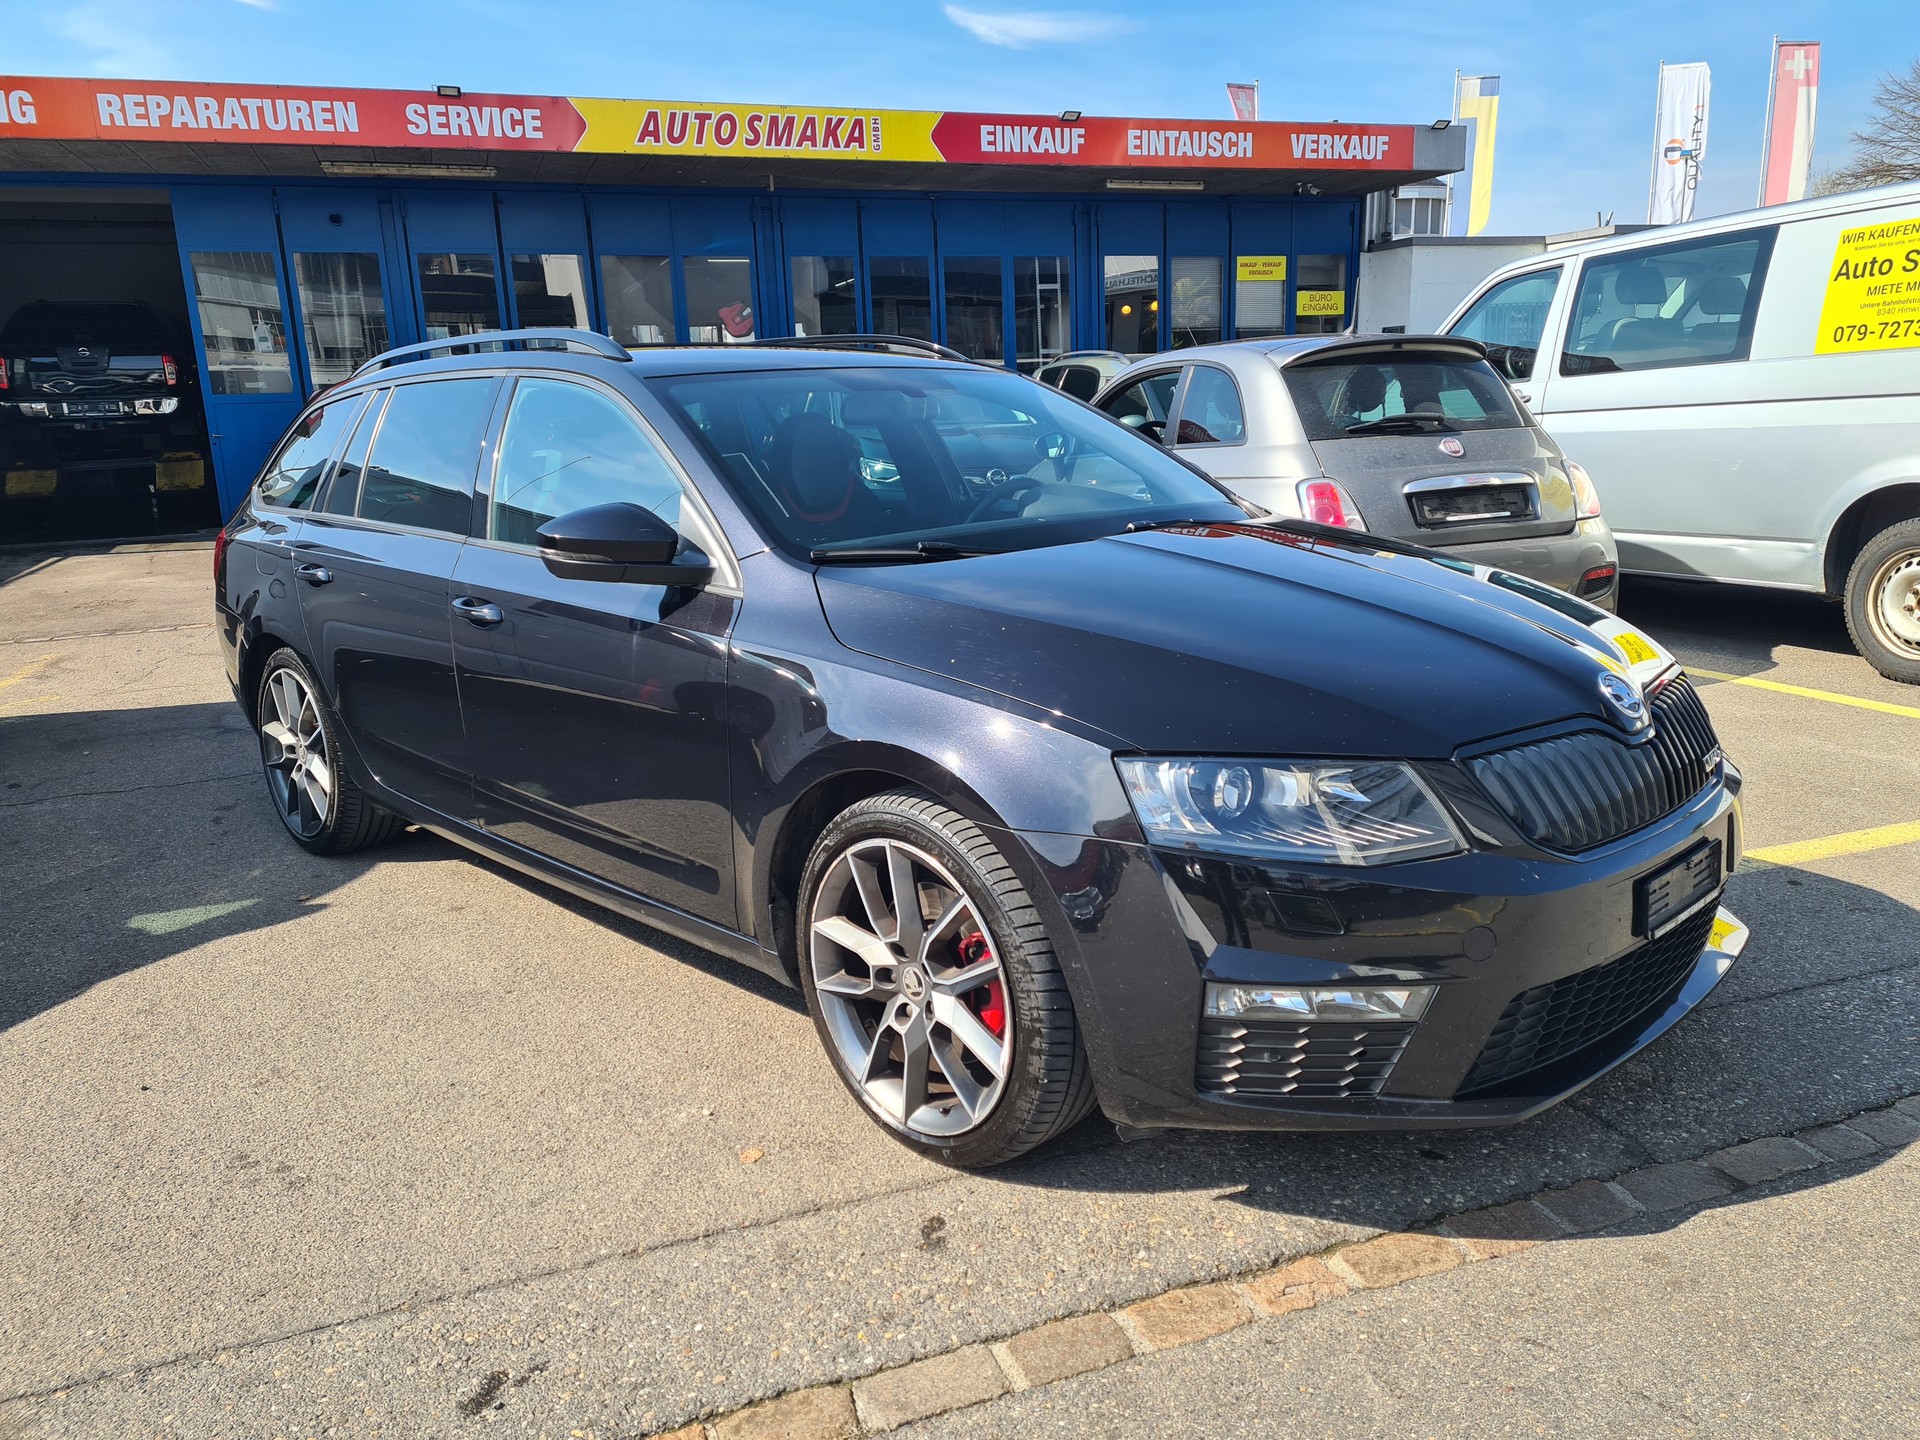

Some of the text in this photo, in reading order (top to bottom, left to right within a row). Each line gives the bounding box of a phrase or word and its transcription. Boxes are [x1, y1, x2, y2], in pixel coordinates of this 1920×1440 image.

[96, 93, 359, 133] REPARATUREN
[406, 103, 543, 139] SERVICE
[635, 109, 867, 151] AUTO SMAKA
[871, 116, 882, 152] GMBH
[980, 124, 1085, 154] EINKAUF
[1127, 129, 1253, 158] EINTAUSCH
[1290, 133, 1389, 160] VERKAUF
[1842, 223, 1920, 245] WIR KAUFEN
[1833, 256, 1894, 282] Auto
[1309, 293, 1333, 302] BÜRO
[1867, 282, 1903, 297] MIETE
[1302, 302, 1339, 312] EINGANG
[1876, 307, 1896, 316] 8340
